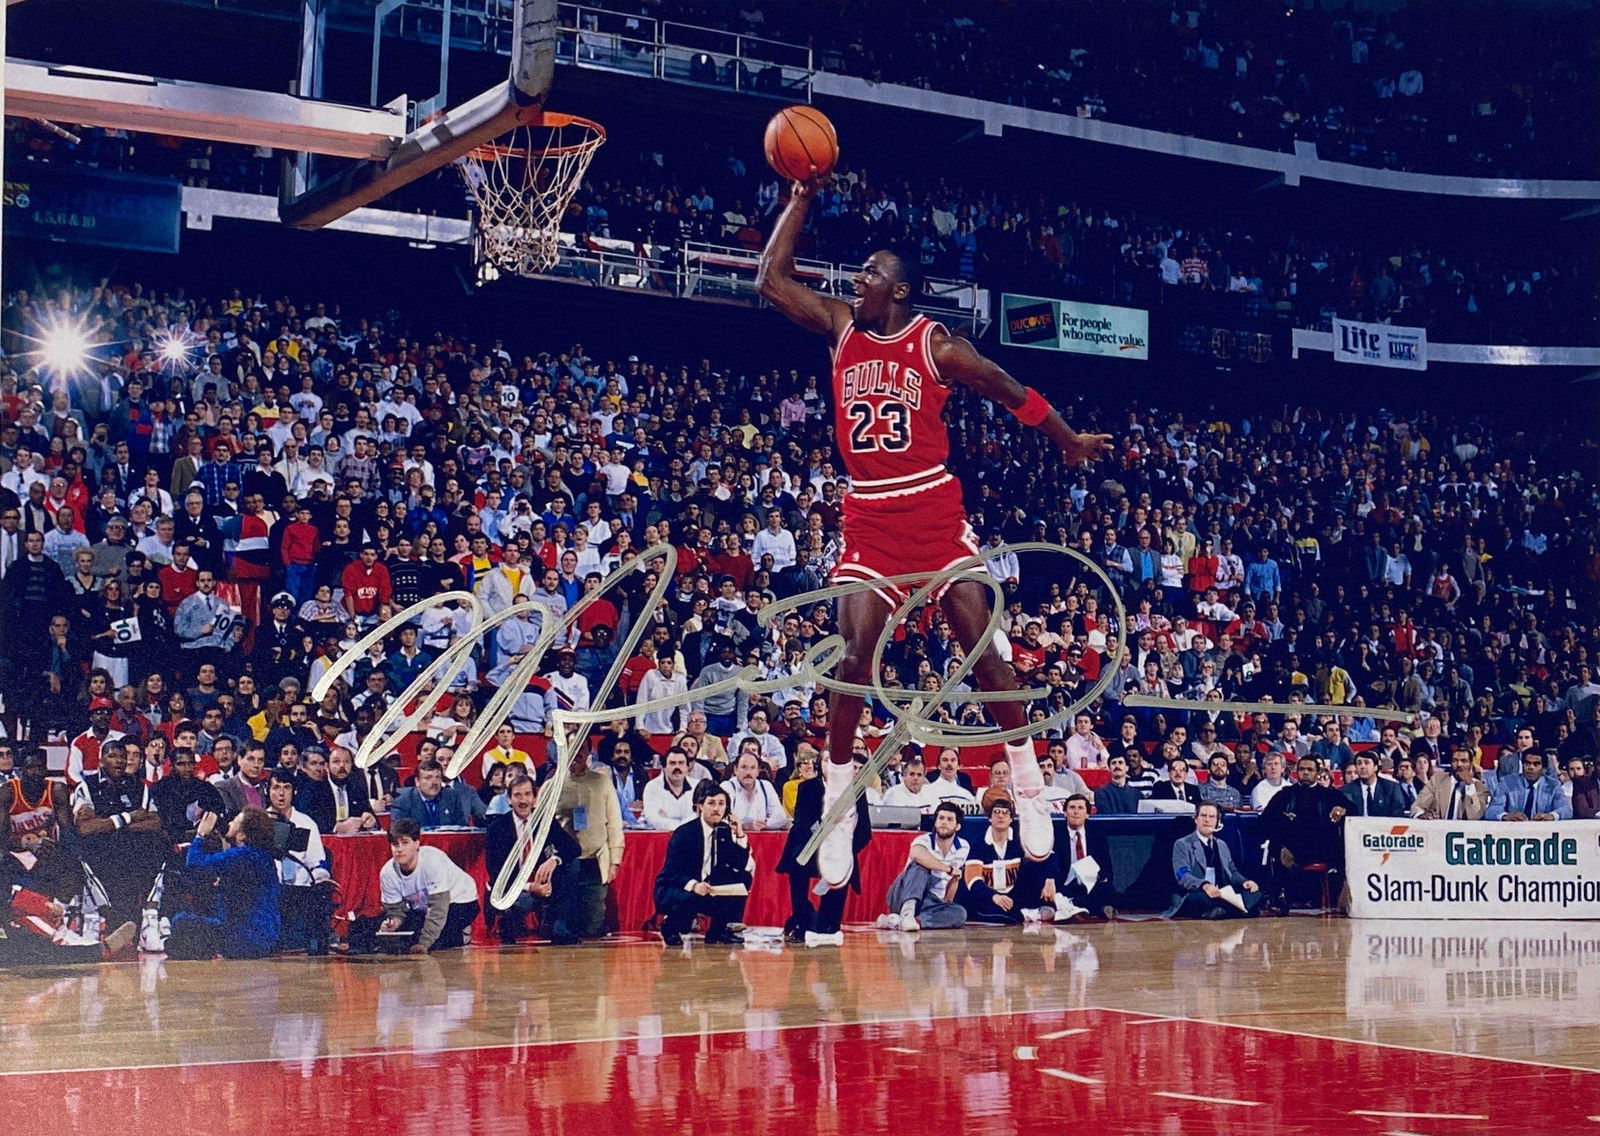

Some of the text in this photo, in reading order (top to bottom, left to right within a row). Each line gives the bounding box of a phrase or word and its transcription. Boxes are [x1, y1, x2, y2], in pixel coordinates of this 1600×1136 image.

[1062, 312, 1112, 331] For people
[1062, 327, 1083, 340] who
[1084, 331, 1117, 345] expect
[1118, 334, 1146, 347] value.
[1339, 324, 1380, 355] Lite
[842, 359, 922, 411] BULLS
[502, 391, 516, 402] 10
[847, 400, 912, 454] 23
[116, 620, 132, 641] 10
[214, 614, 230, 631] 10
[1362, 834, 1424, 848] Gatorade
[1445, 832, 1578, 865] Gatorade
[1367, 873, 1488, 902] Slam-Dunk
